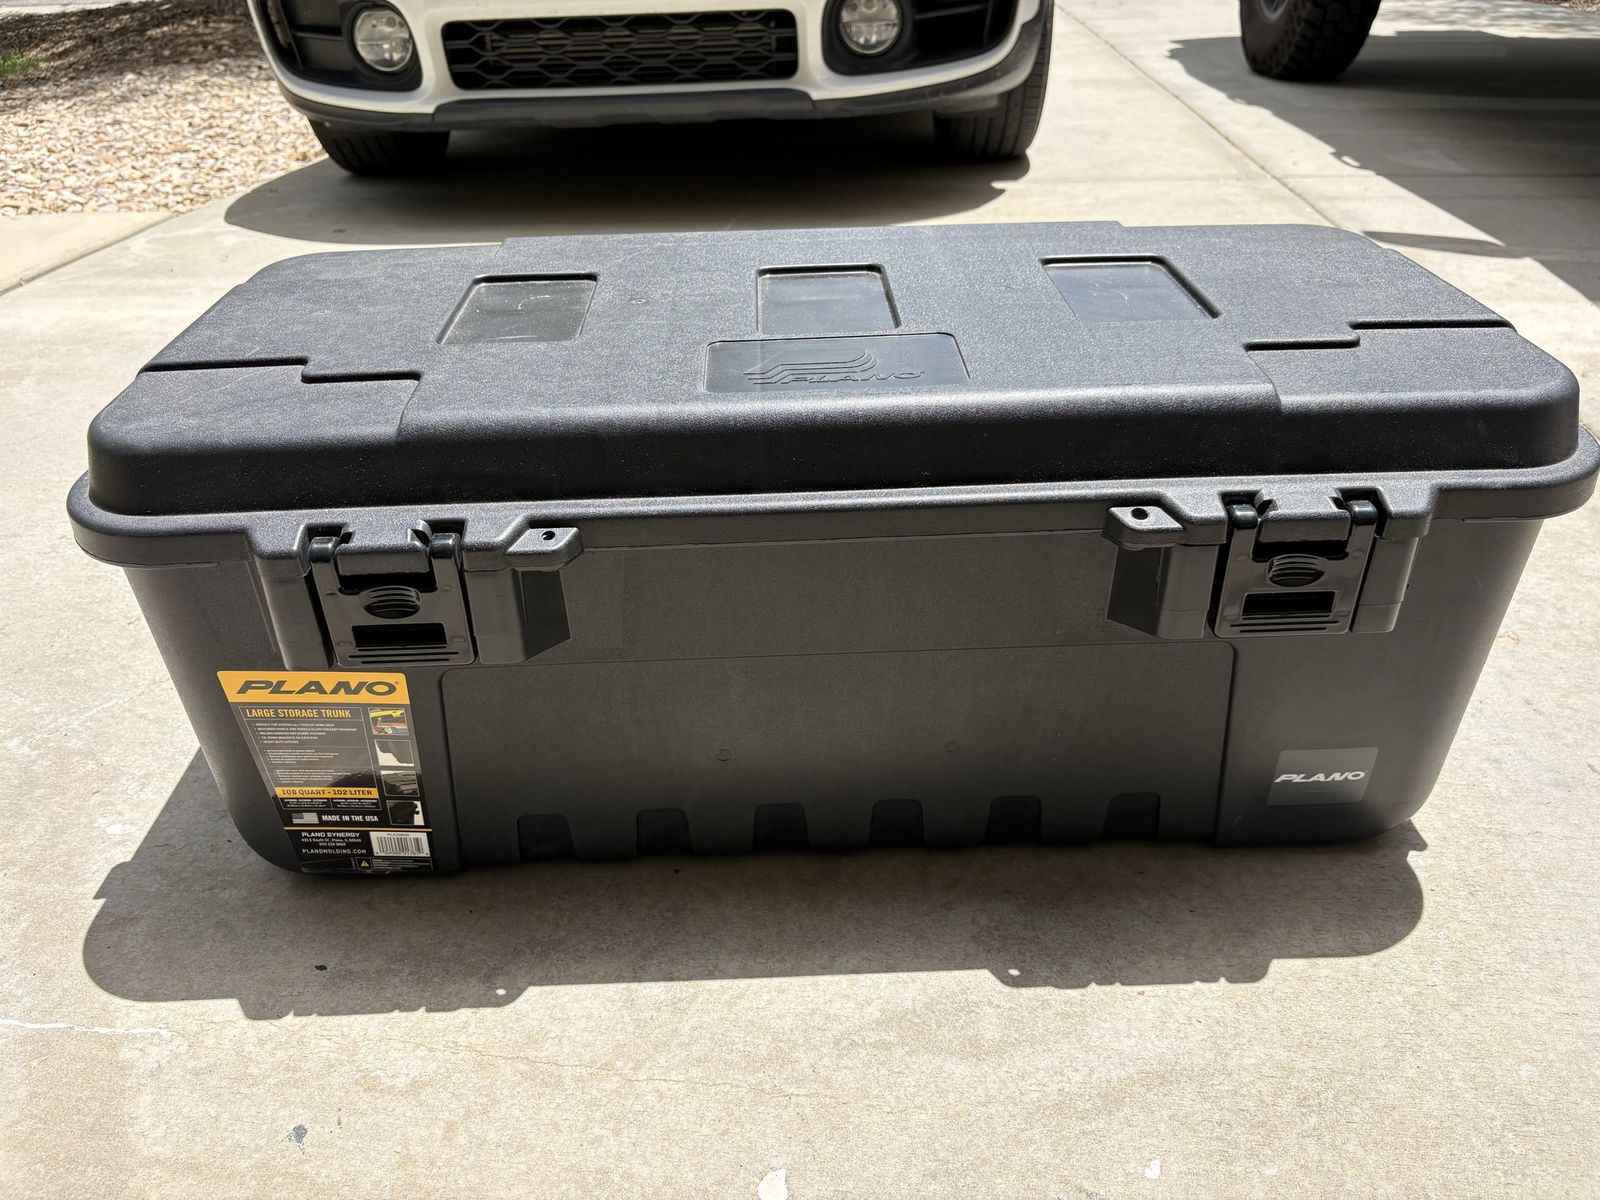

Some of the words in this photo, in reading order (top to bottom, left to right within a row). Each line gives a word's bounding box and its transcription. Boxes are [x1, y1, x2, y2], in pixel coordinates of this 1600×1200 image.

[236, 680, 398, 696] PLANO
[246, 709, 276, 718] LARGE
[278, 709, 320, 718] STORAGE
[320, 710, 352, 718] TRUNK
[1274, 771, 1365, 782] PLANO
